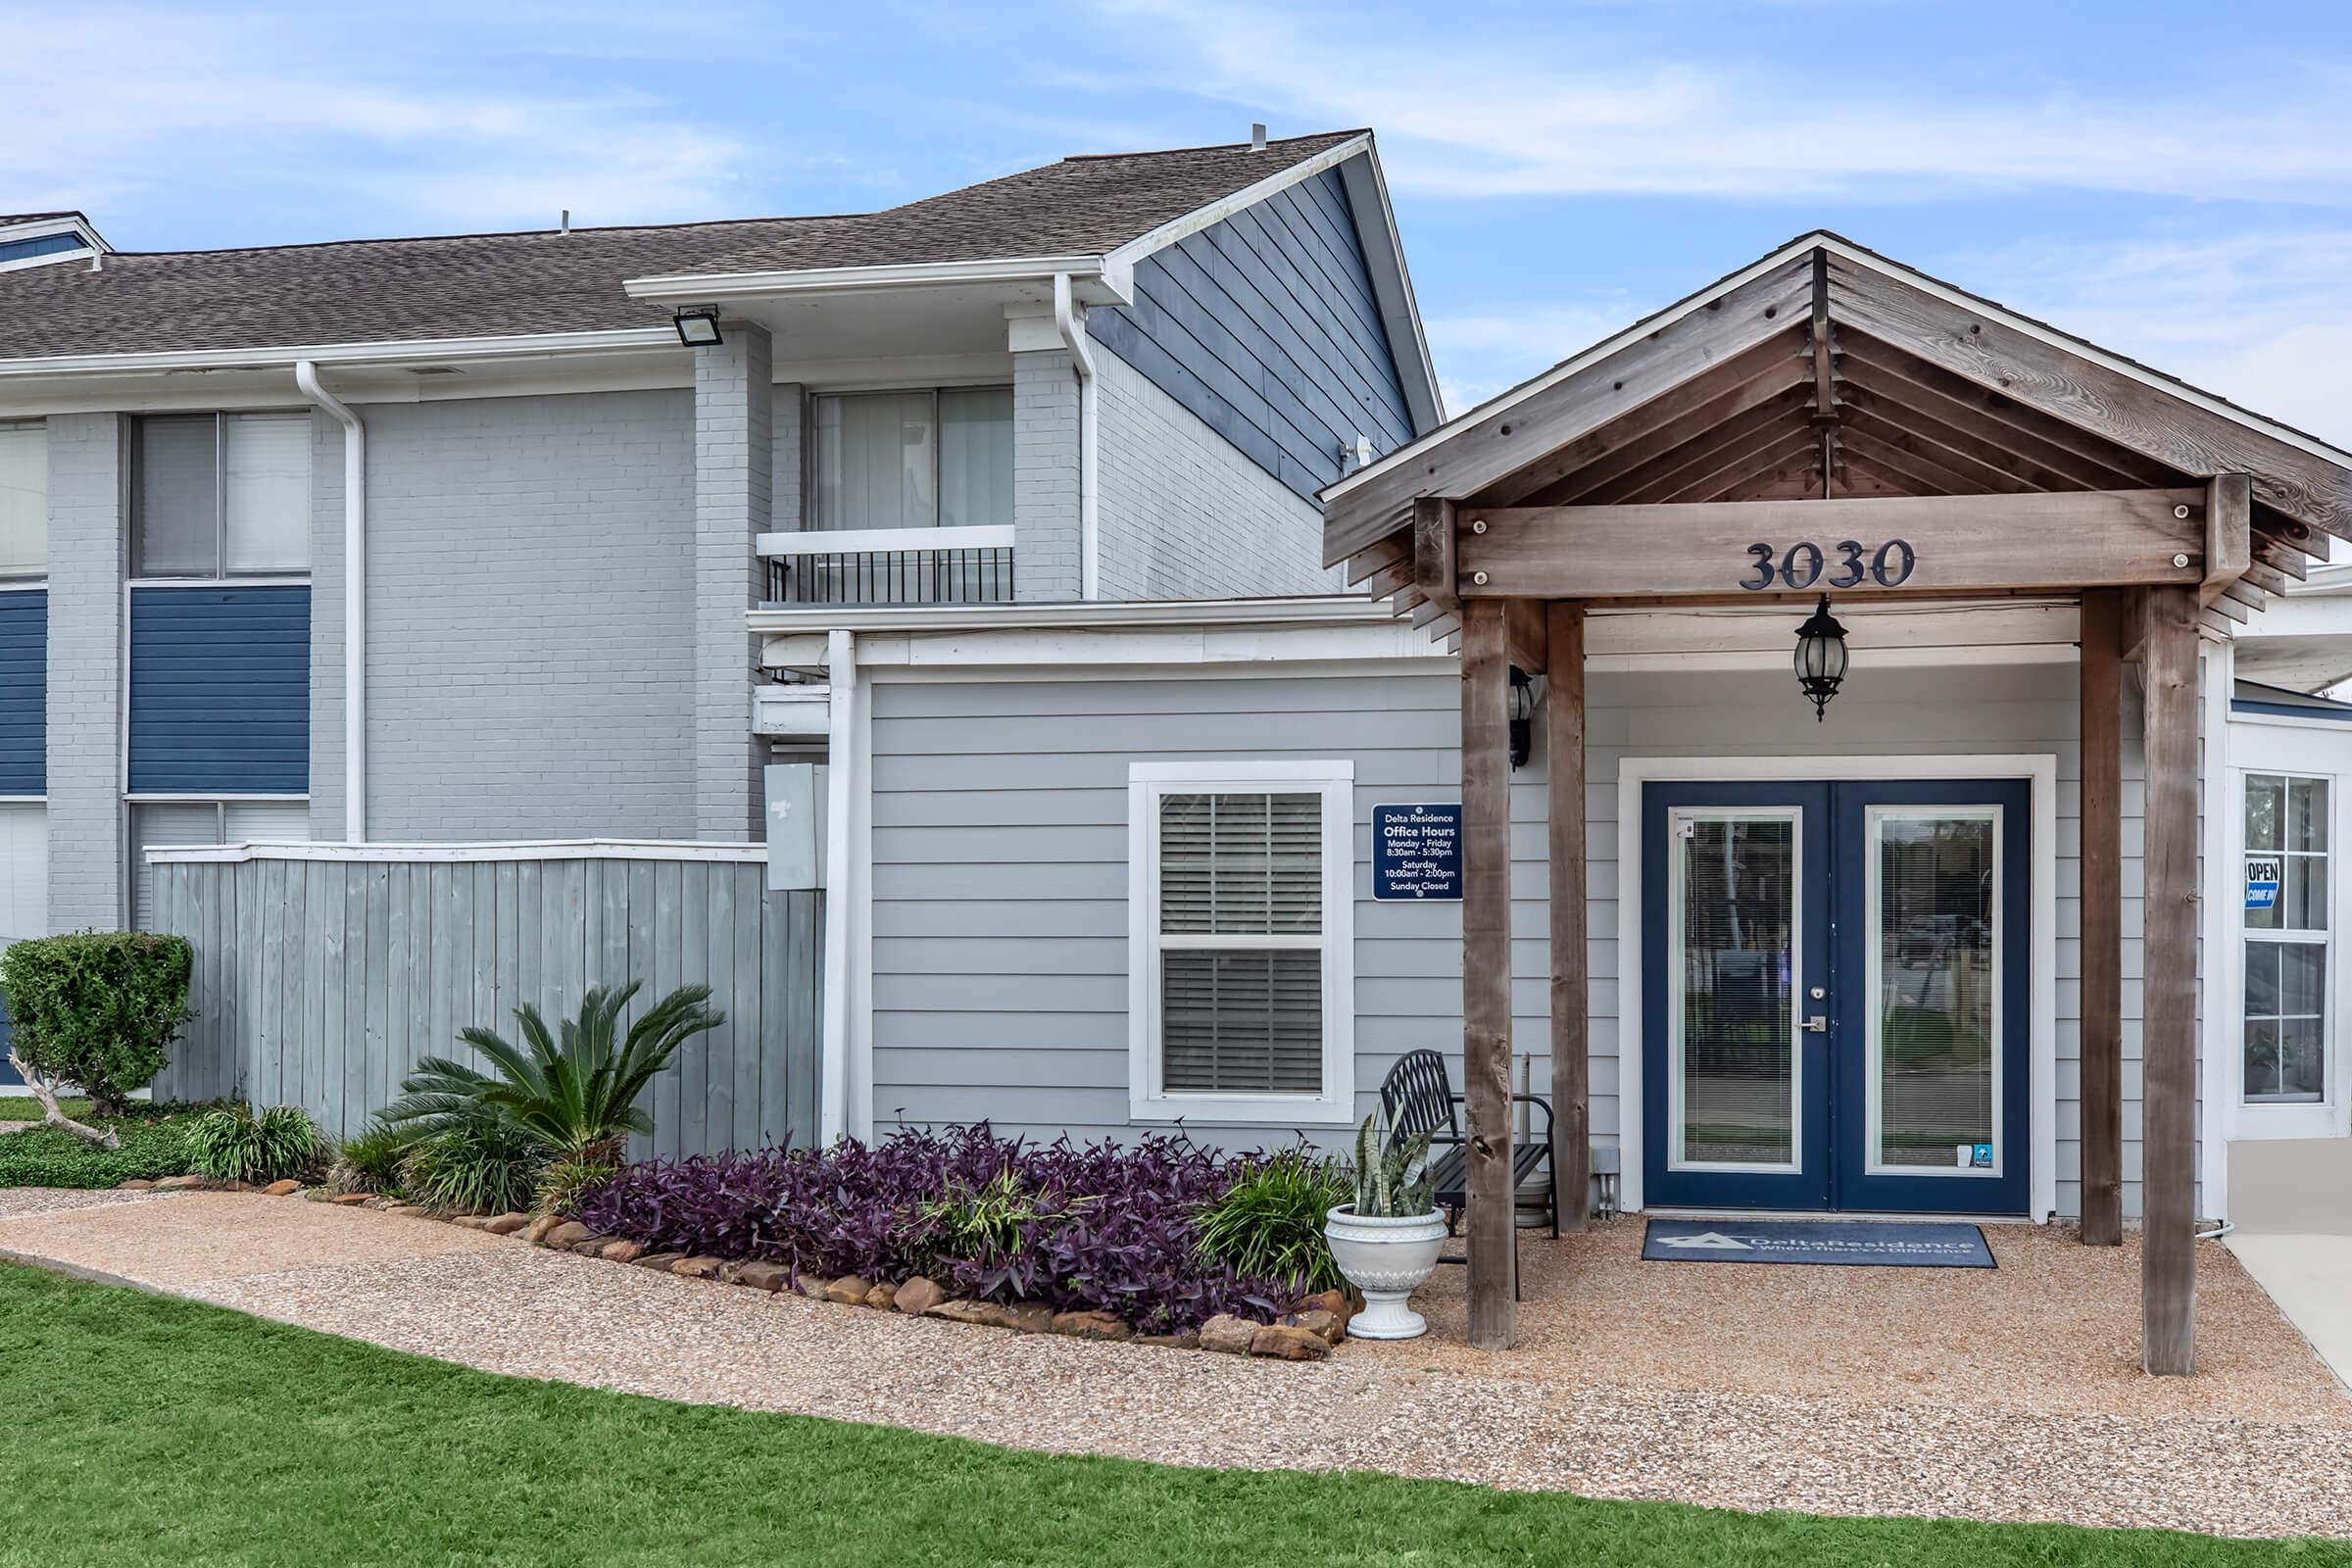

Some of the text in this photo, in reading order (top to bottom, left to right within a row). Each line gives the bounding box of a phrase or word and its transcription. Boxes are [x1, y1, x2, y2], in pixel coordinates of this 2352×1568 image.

[1740, 539, 1915, 590] 3030
[1385, 814, 1453, 823] Delta Residence
[1384, 826, 1455, 837] Office Hours
[1388, 840, 1420, 849] Monday
[1426, 839, 1451, 849] Friday
[1422, 848, 1452, 858] 5:30pm
[1402, 860, 1438, 870] Saturday
[1425, 869, 1455, 879] 2:00pm
[2247, 862, 2278, 881] OPEN
[1391, 881, 1449, 892] Sunday Closed
[2247, 889, 2268, 901] COME
